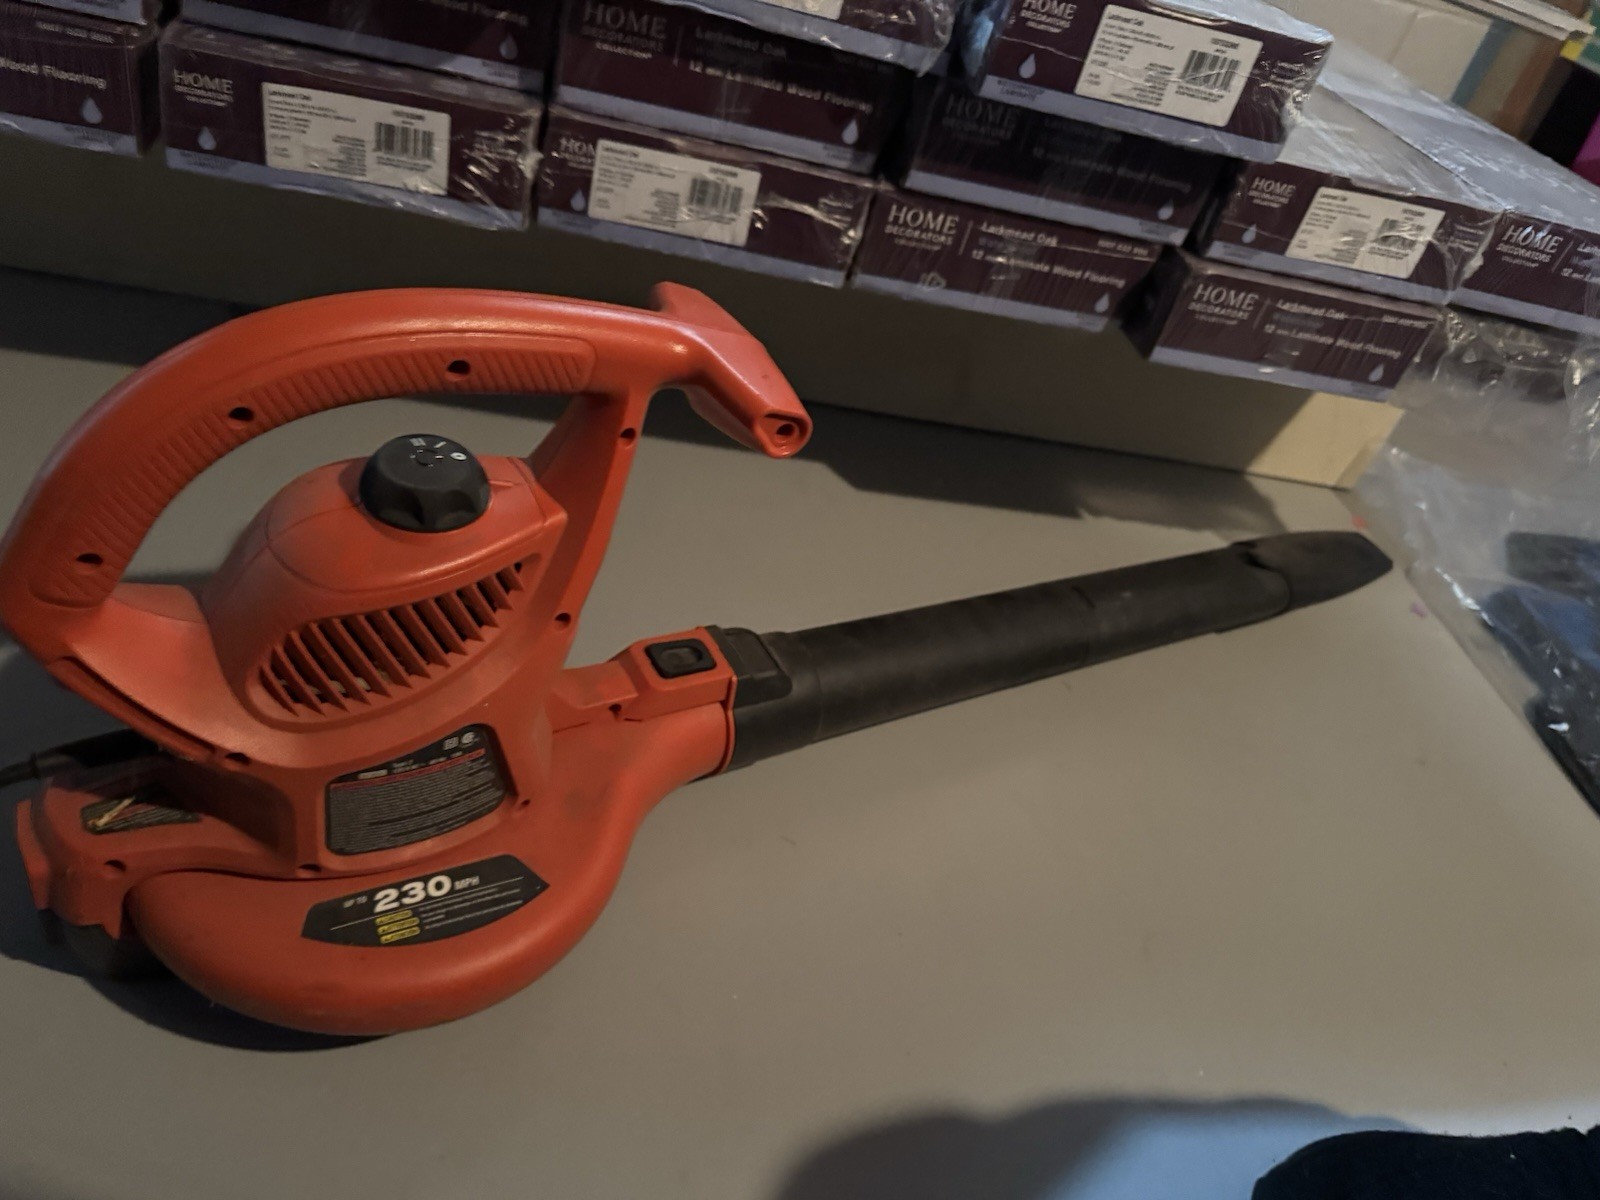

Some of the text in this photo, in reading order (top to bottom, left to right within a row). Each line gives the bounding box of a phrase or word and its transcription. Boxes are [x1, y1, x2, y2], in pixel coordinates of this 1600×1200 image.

[583, 1, 667, 39] HOME
[1021, 0, 1078, 20] HOME
[41, 64, 107, 89] Flooring
[172, 67, 235, 94] HOME
[786, 82, 822, 101] Wood
[823, 91, 874, 115] Flooring
[945, 92, 1019, 130] HOME
[559, 137, 595, 157] HOM
[1250, 176, 1297, 198] HOME
[887, 201, 960, 235] HOME
[884, 224, 955, 247] DECORATORS
[1501, 224, 1564, 254] HOME
[1051, 263, 1083, 280] Wood
[1082, 269, 1127, 290] Flooring
[1193, 282, 1260, 312] HOME
[373, 874, 453, 914] 230
[453, 875, 481, 891] MPH
